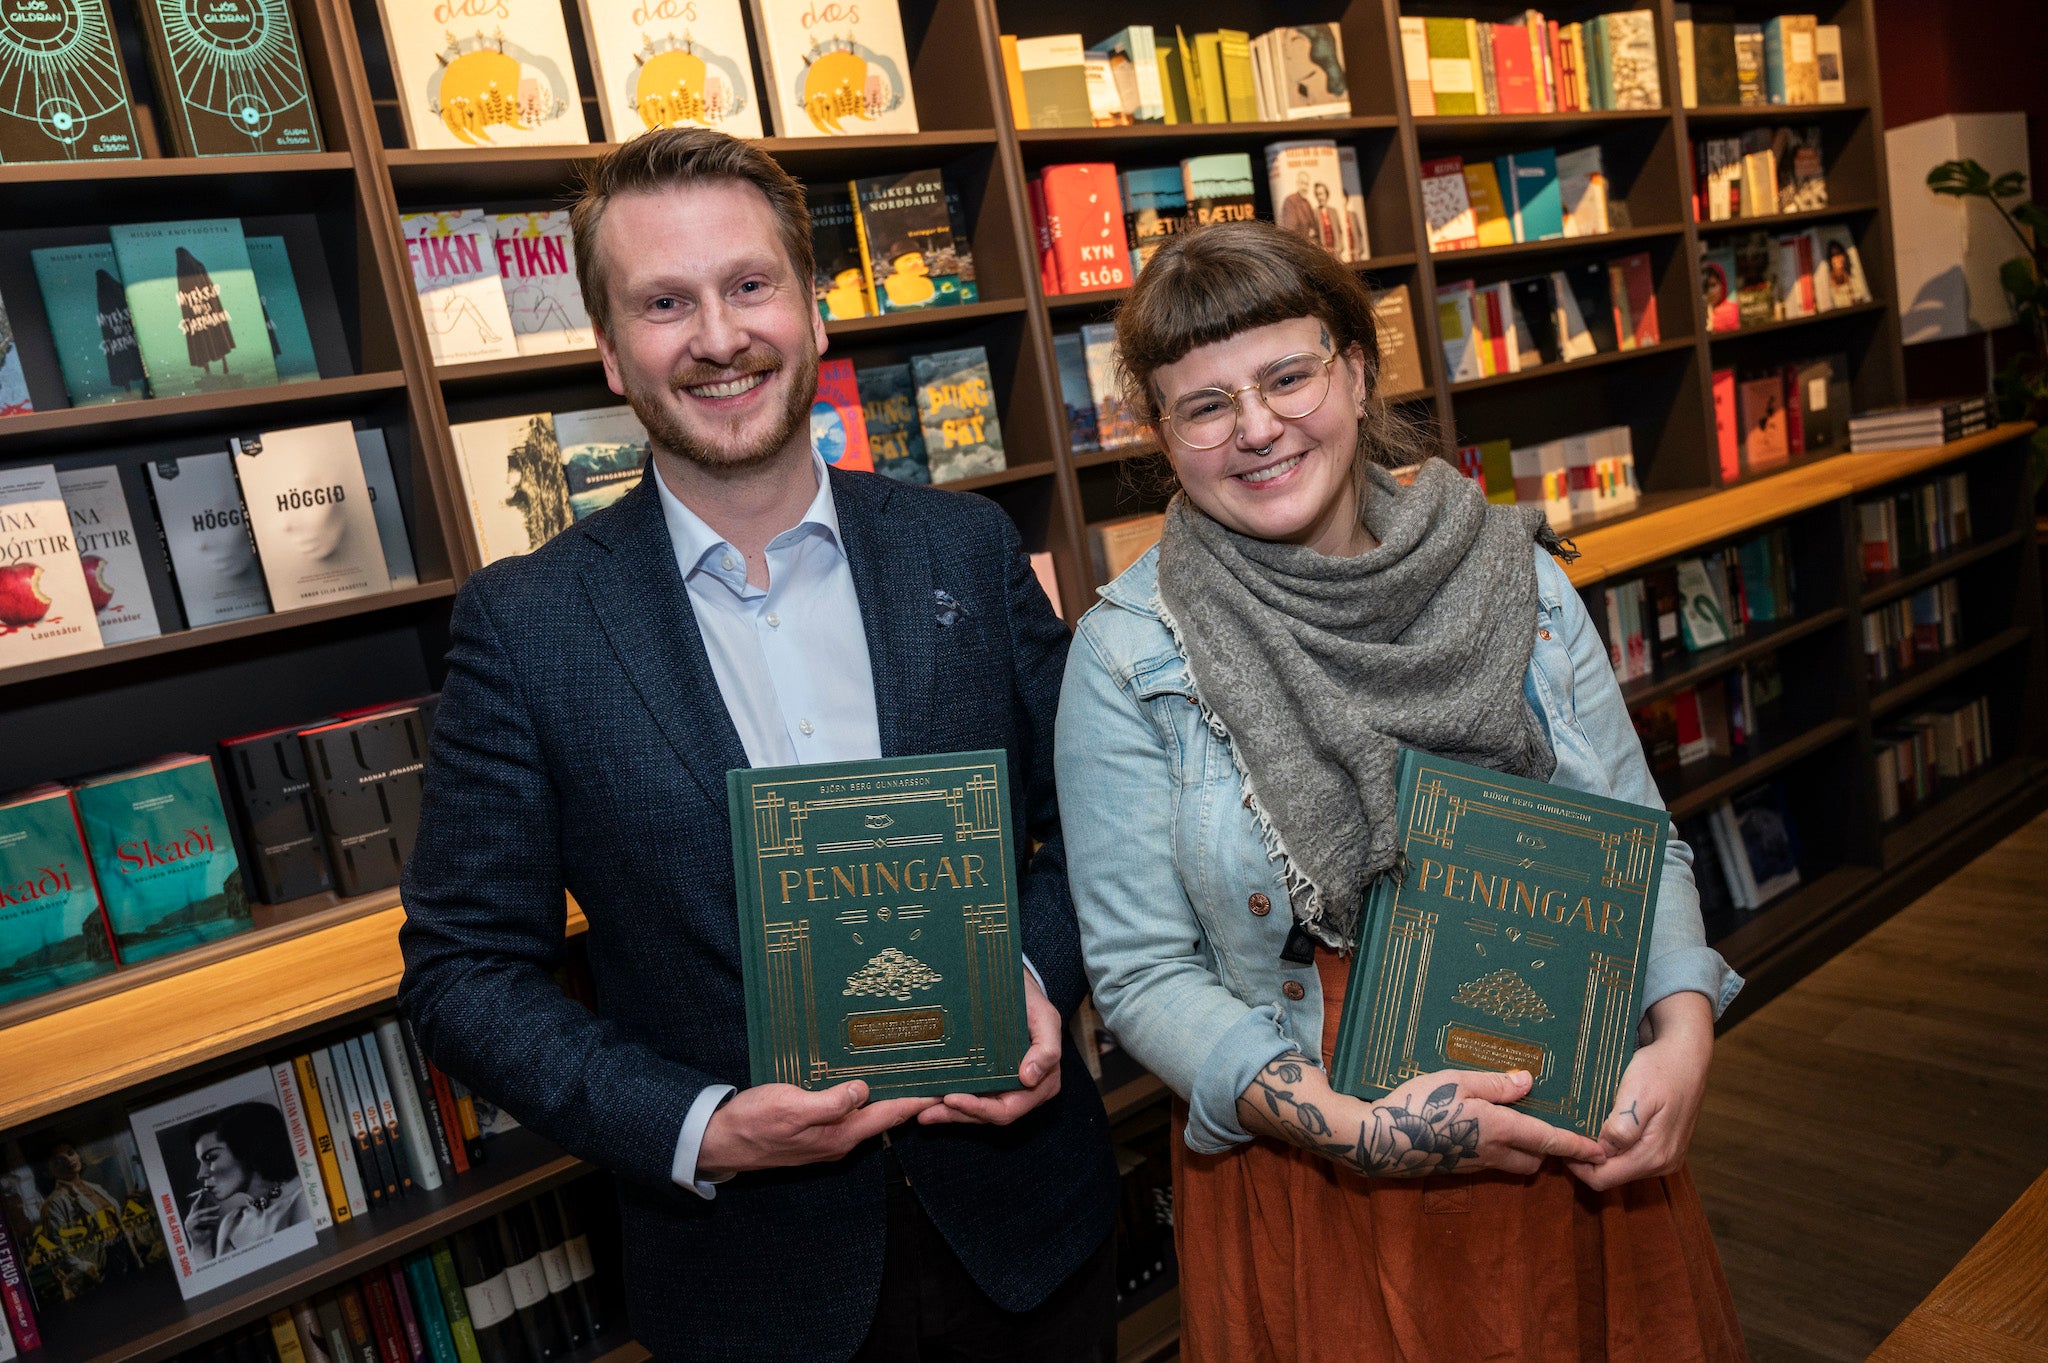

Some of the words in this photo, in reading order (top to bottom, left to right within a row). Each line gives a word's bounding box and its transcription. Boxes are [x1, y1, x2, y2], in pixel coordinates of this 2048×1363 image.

[10, 12, 62, 23] GILDRAN
[204, 13, 250, 23] GILDRAN
[916, 180, 942, 194] ÖRN
[1198, 204, 1255, 226] RÆTUR
[405, 228, 483, 278] FÍKN
[495, 228, 568, 278] FÍKN
[1081, 245, 1114, 260] KYN
[1080, 267, 1123, 286] SLÓÐ
[277, 484, 345, 512] HÖGGIÐ
[31, 624, 82, 642] Launsátur
[359, 771, 387, 784] RAGNAR
[820, 783, 846, 794] BJÖRN
[850, 781, 872, 792] BERG
[875, 777, 931, 789] GUNNARSSON
[1482, 790, 1509, 803] BJÖRN
[1512, 797, 1534, 809] BERG
[1537, 802, 1592, 823] GUNNARSSON
[117, 824, 215, 874] Skaði
[779, 854, 989, 904] PENINGAR
[1417, 857, 1625, 940] PENINGAR
[317, 1136, 330, 1154] EIN
